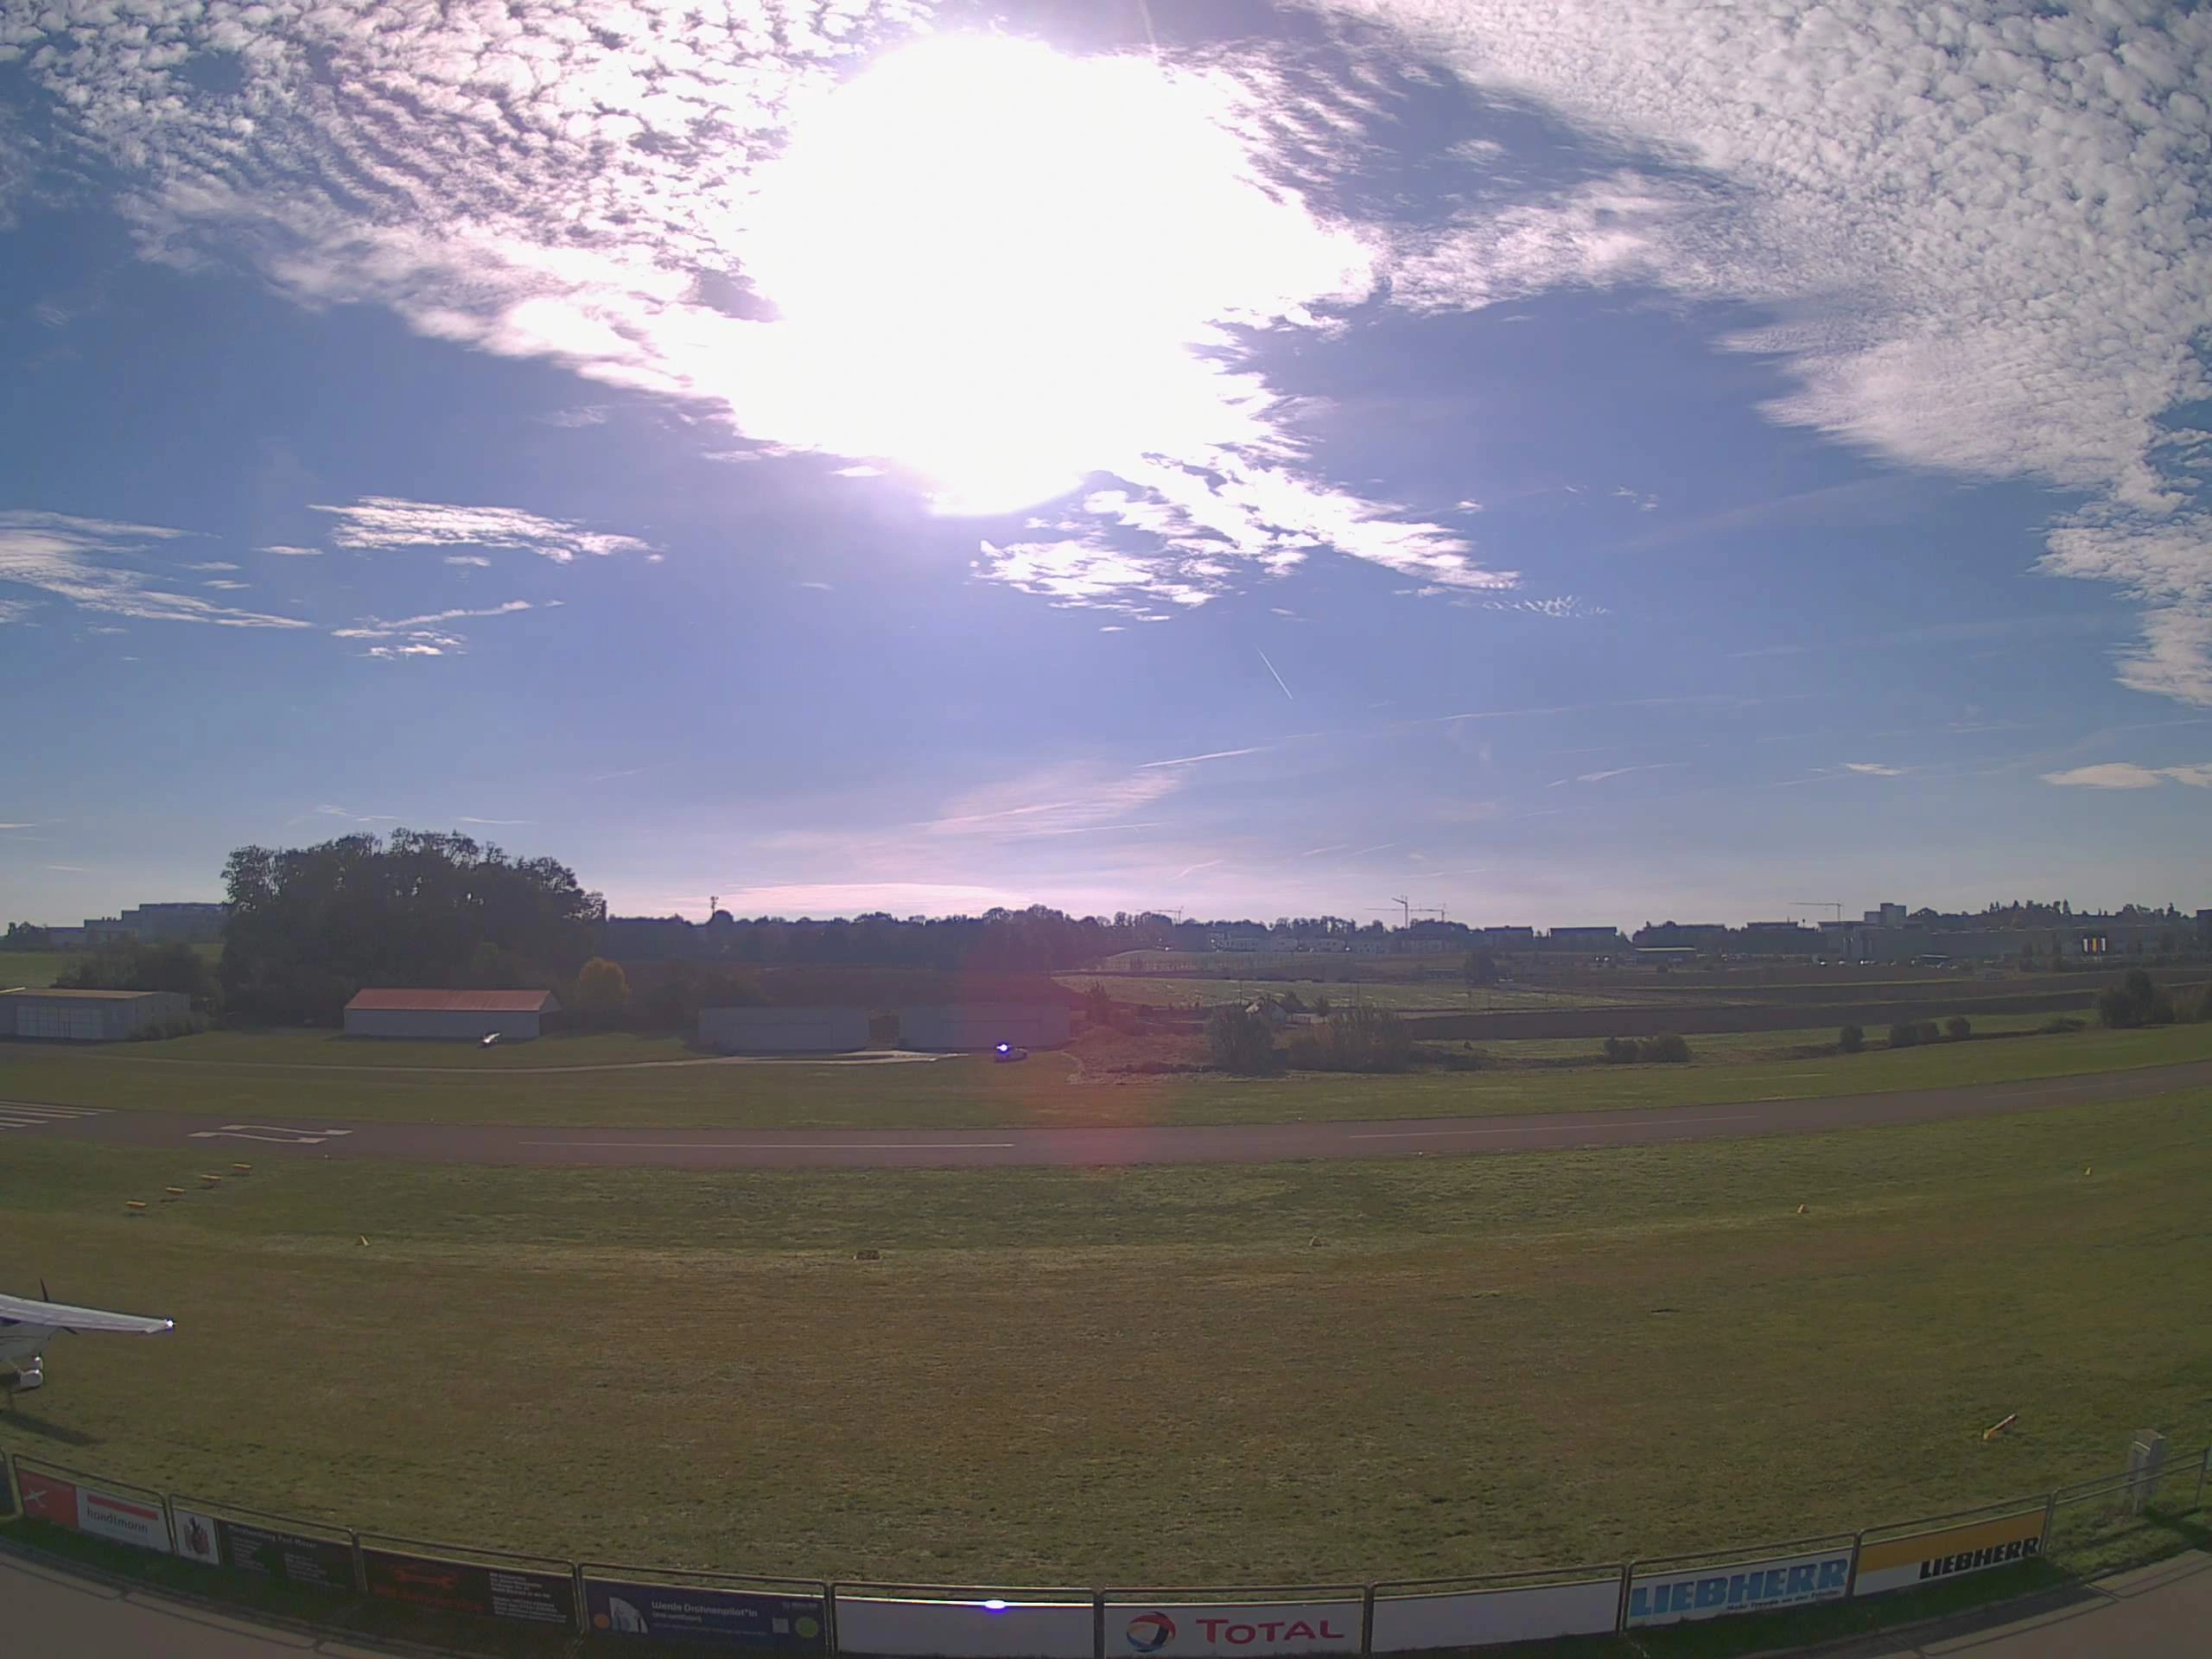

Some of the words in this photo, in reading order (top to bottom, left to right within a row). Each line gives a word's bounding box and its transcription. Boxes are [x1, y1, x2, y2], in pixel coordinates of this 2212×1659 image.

[1919, 1536, 2040, 1580] LIEBHERR
[1630, 1558, 1847, 1618] LIEBHERR
[1196, 1618, 1344, 1645] TOTAL
